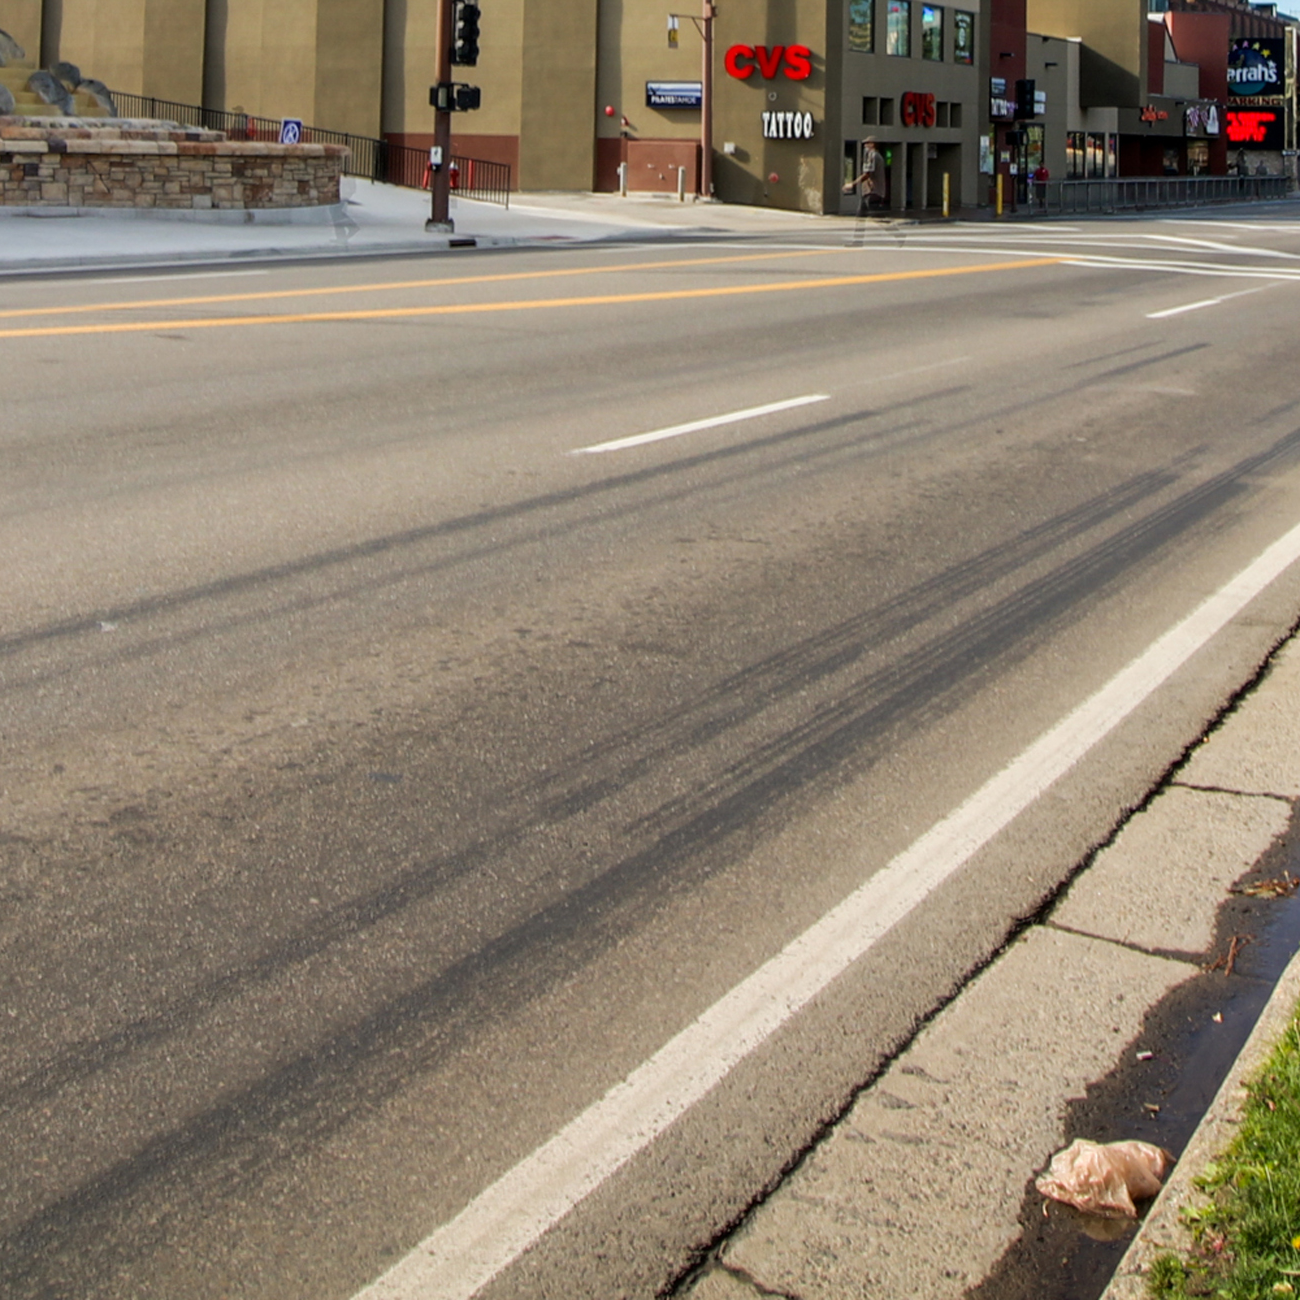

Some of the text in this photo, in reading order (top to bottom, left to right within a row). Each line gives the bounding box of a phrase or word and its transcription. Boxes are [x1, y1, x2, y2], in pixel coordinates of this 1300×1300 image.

[724, 44, 812, 80] CVS
[1226, 62, 1278, 83] arrah's
[761, 111, 814, 139] TATTOO
[903, 91, 935, 127] CVS
